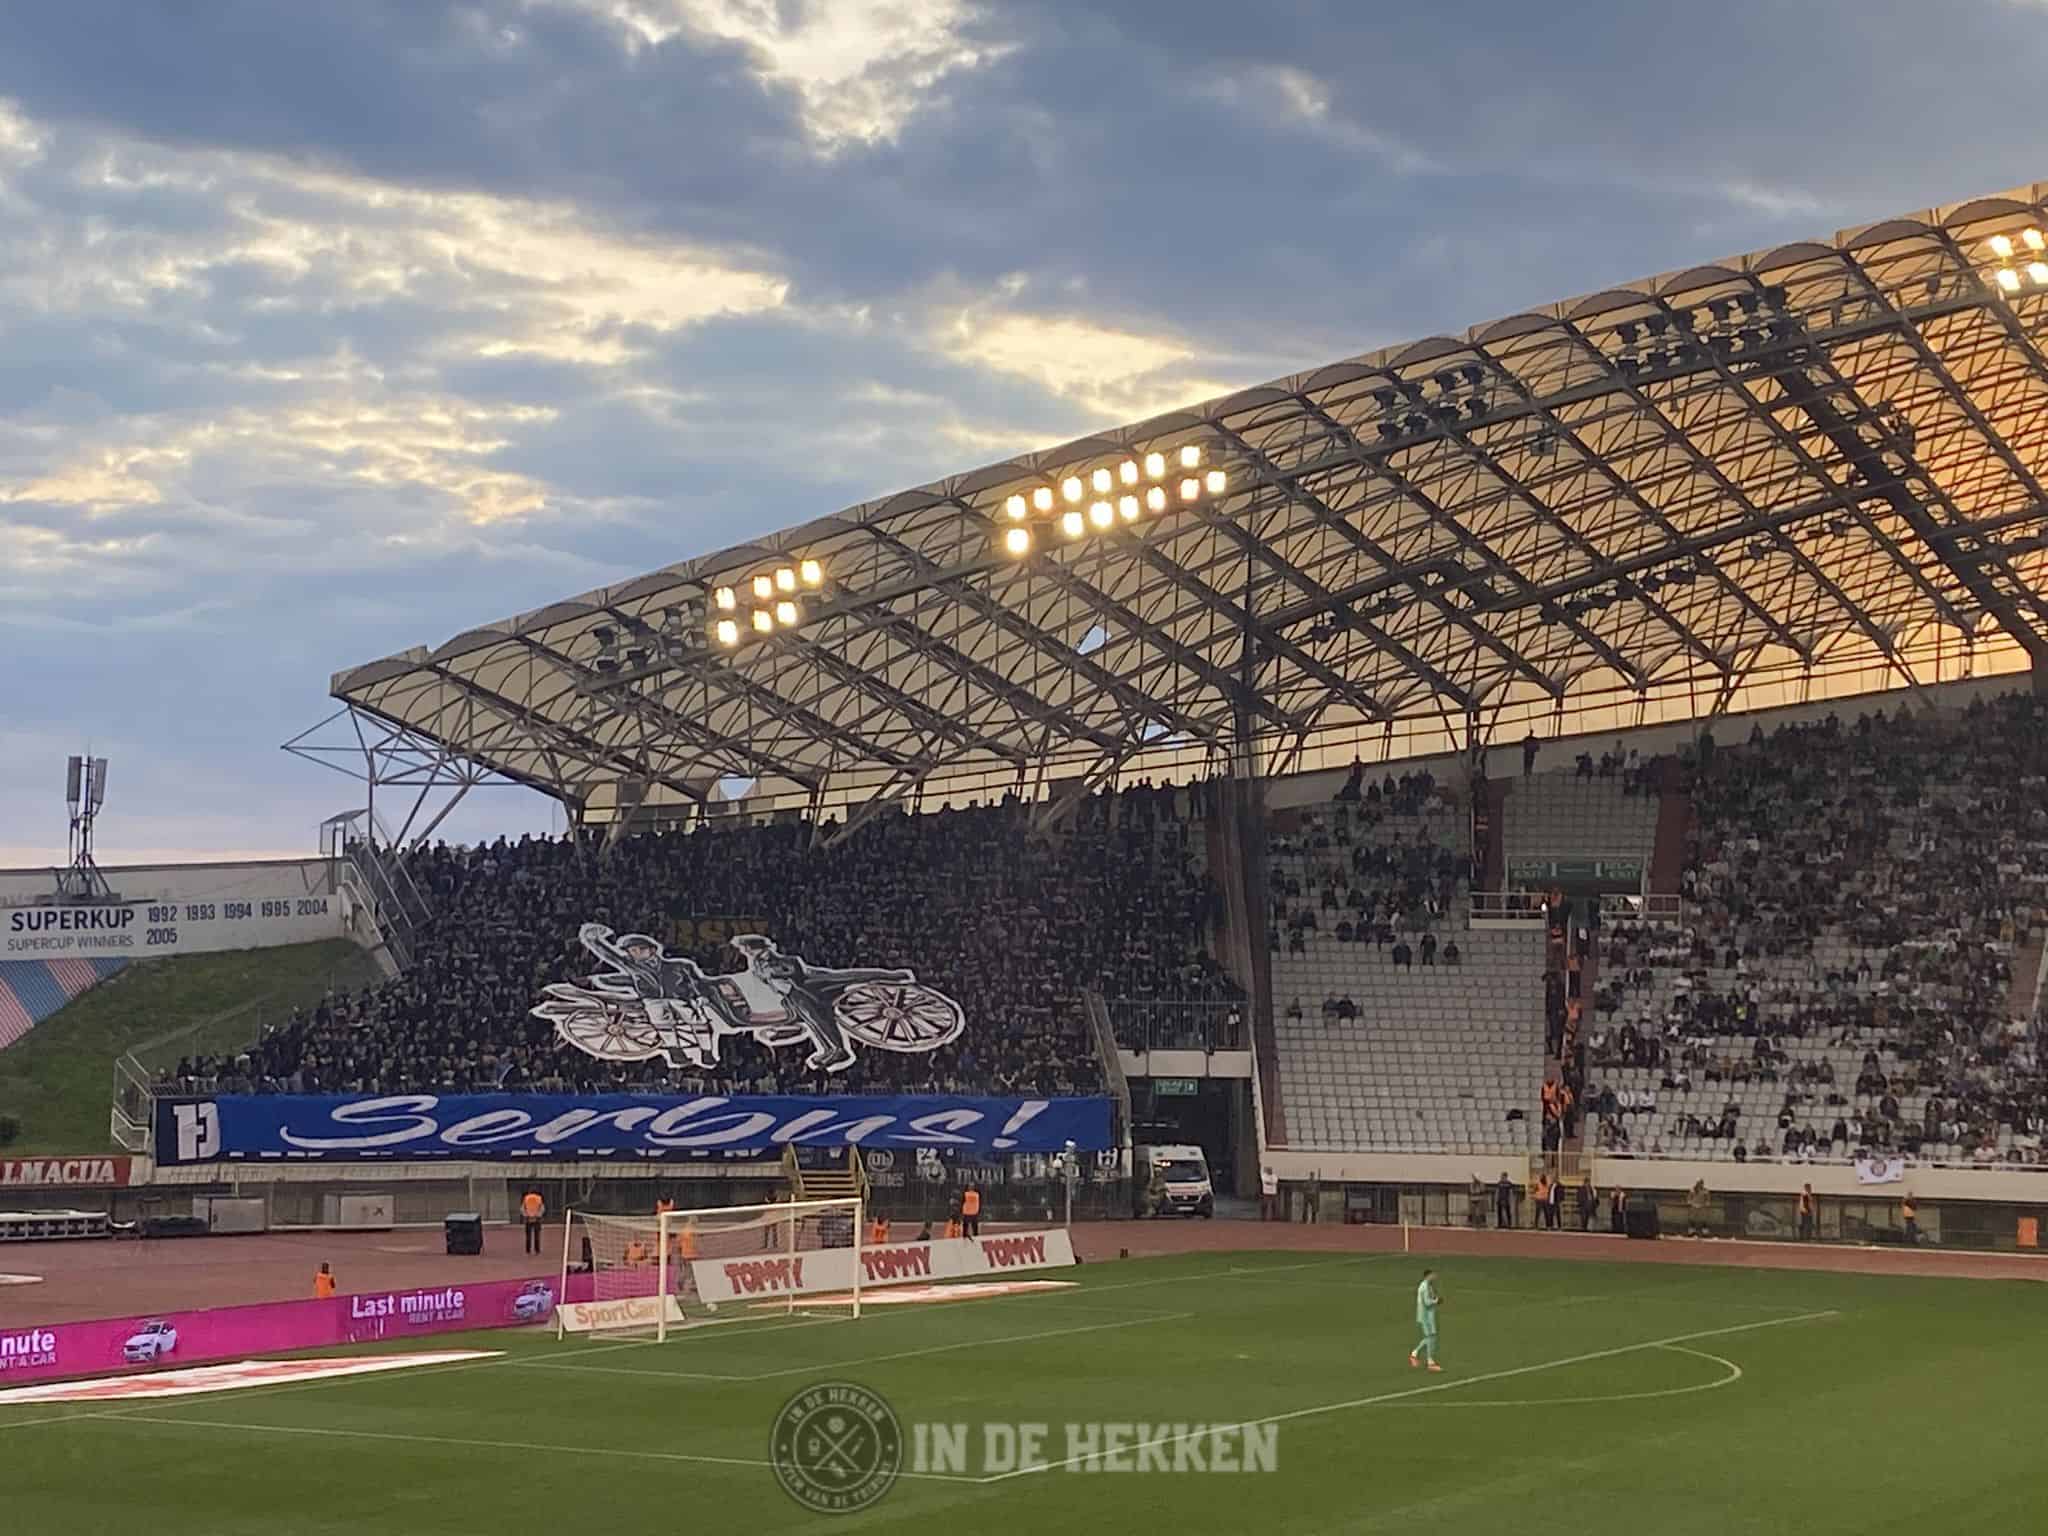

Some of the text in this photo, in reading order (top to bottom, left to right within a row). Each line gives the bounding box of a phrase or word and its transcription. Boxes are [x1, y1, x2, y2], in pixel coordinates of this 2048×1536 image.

[11, 898, 328, 931] SUPERKUP 1992 1993 1994 1995 2004
[7, 928, 178, 951] SUPERCUP WINNERS 2005
[279, 1095, 1049, 1148] Serbus!
[860, 1246, 931, 1280] TOMMY
[981, 1235, 1047, 1268] TOMMY
[724, 1257, 803, 1294] TOMMY
[352, 1287, 464, 1318] Last minute
[31, 1352, 56, 1366] CAR
